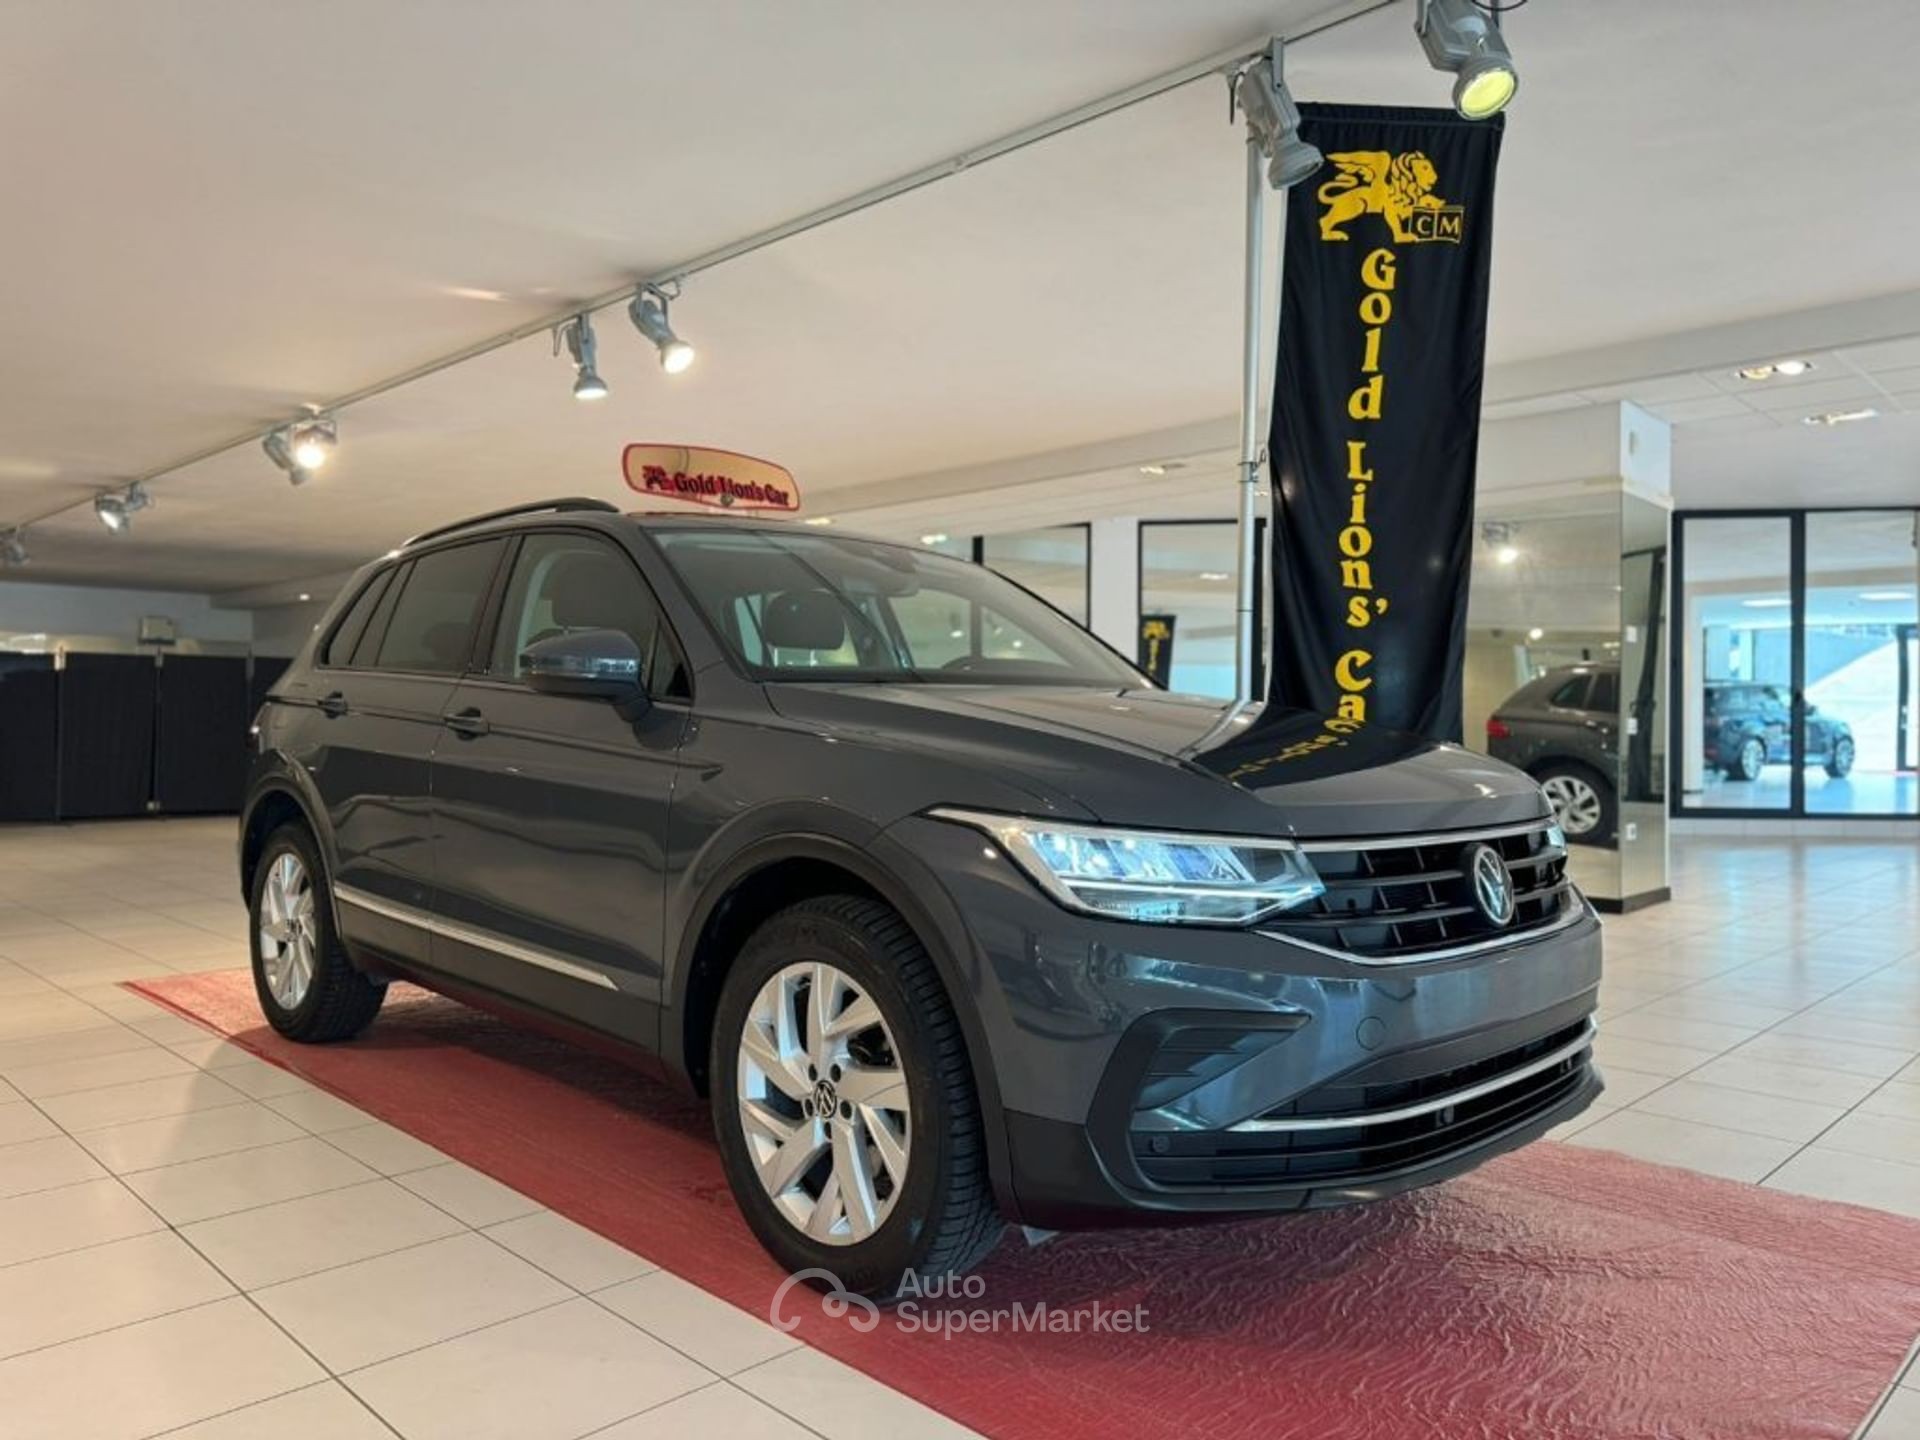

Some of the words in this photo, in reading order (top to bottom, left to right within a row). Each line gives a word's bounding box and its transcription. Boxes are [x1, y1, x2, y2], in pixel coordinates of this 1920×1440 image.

[1348, 248, 1397, 420] Gold
[673, 472, 718, 495] Gold
[1338, 441, 1388, 628] Lions'
